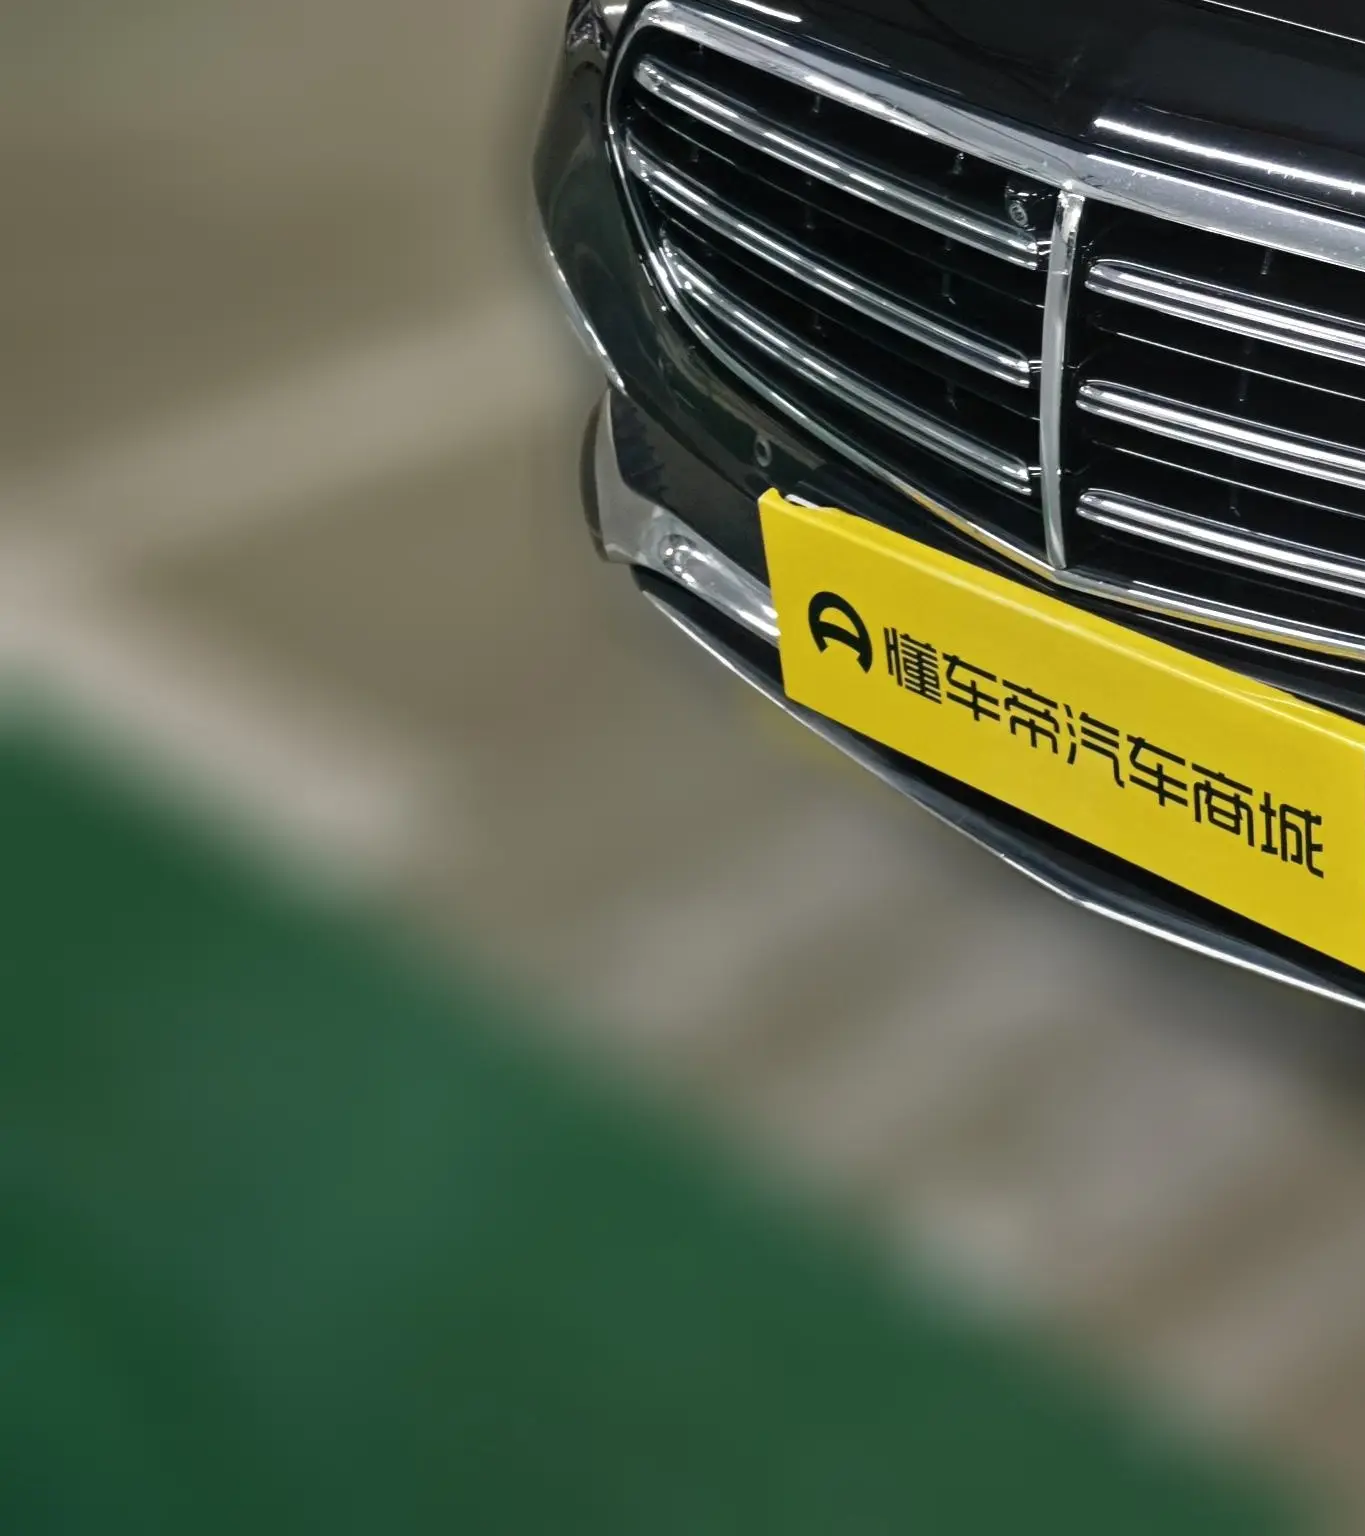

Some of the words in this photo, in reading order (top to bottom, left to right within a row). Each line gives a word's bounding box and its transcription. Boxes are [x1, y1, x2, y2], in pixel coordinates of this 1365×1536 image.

[883, 627, 1324, 879] 懂车帝汽车商城
